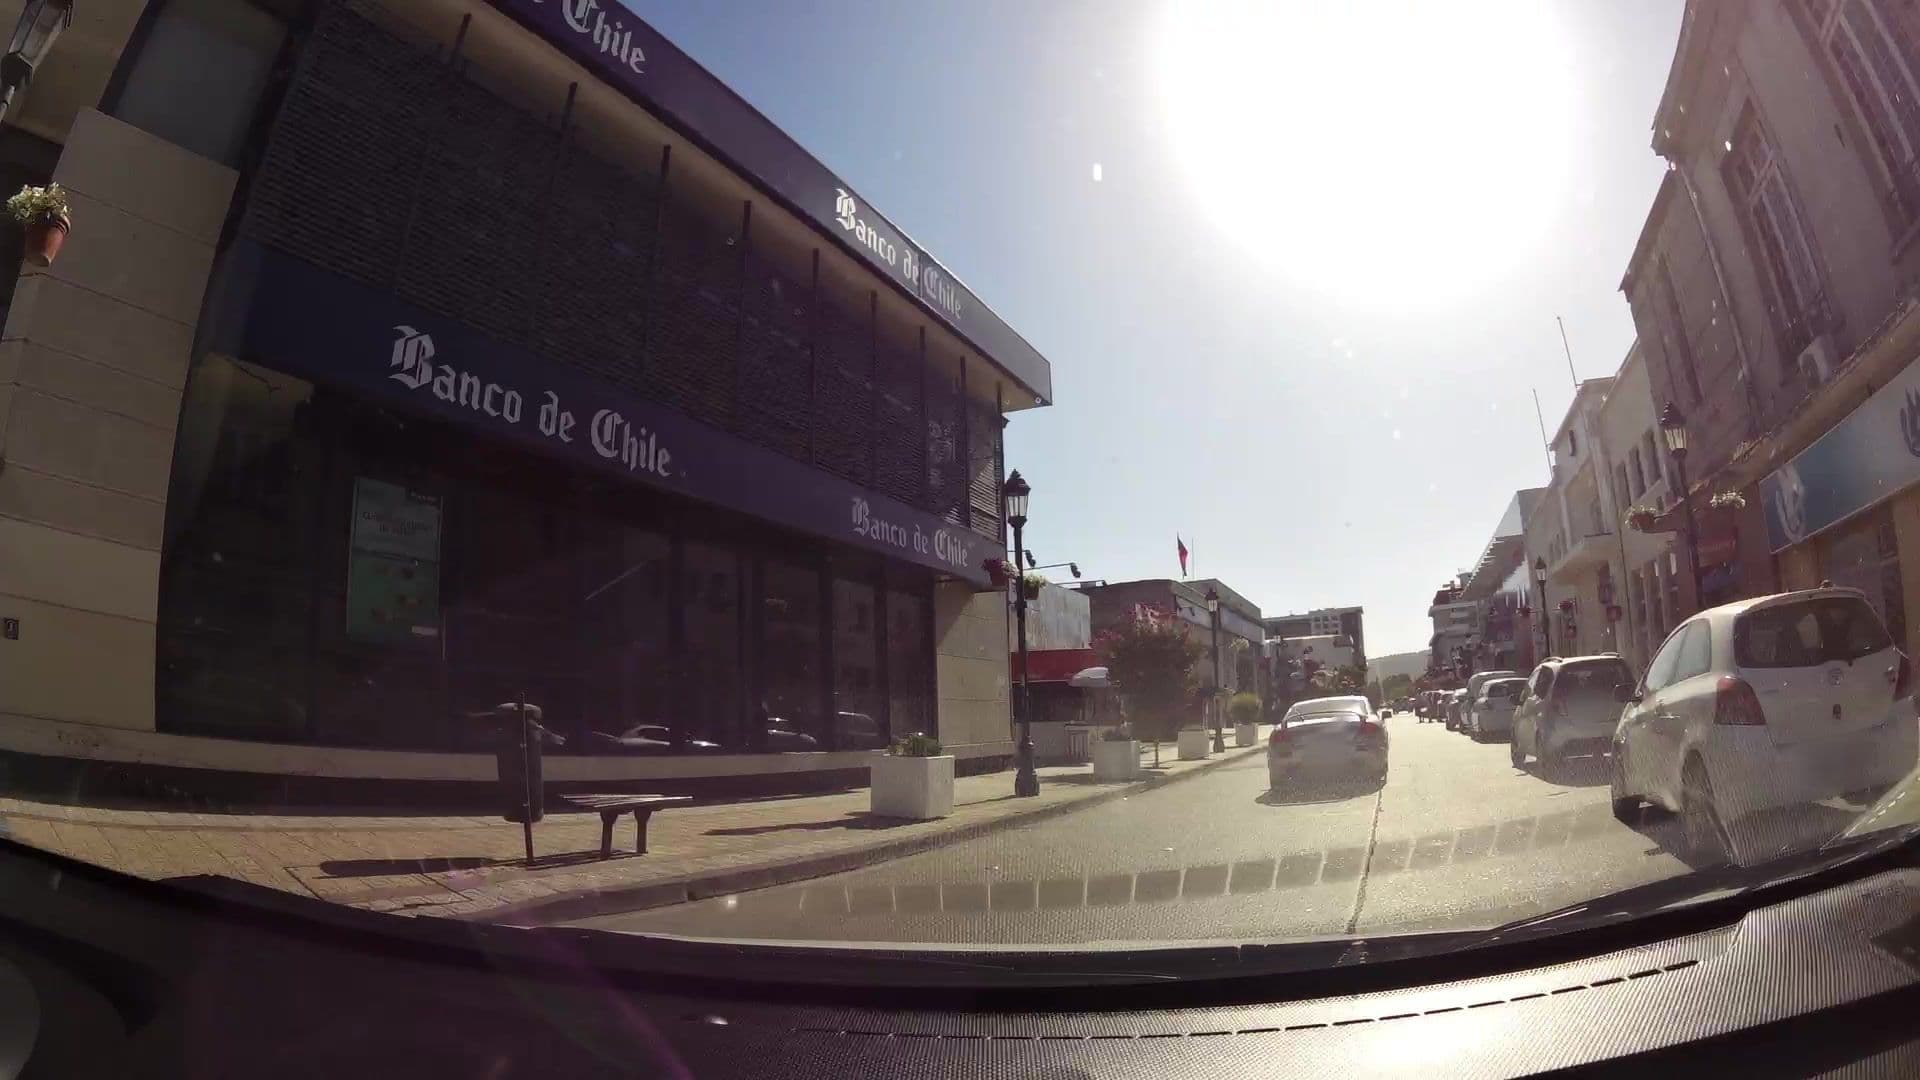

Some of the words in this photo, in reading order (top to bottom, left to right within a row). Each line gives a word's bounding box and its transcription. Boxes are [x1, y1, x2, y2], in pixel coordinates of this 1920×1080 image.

[562, 0, 646, 74] Chile
[835, 188, 897, 267] Banco
[903, 249, 920, 285] de
[923, 265, 962, 320] Chile
[388, 325, 523, 424] Banco
[538, 390, 577, 443] de
[590, 408, 673, 477] Chile
[852, 497, 907, 548] Banco
[913, 524, 928, 555] de
[935, 528, 968, 568] Chile
